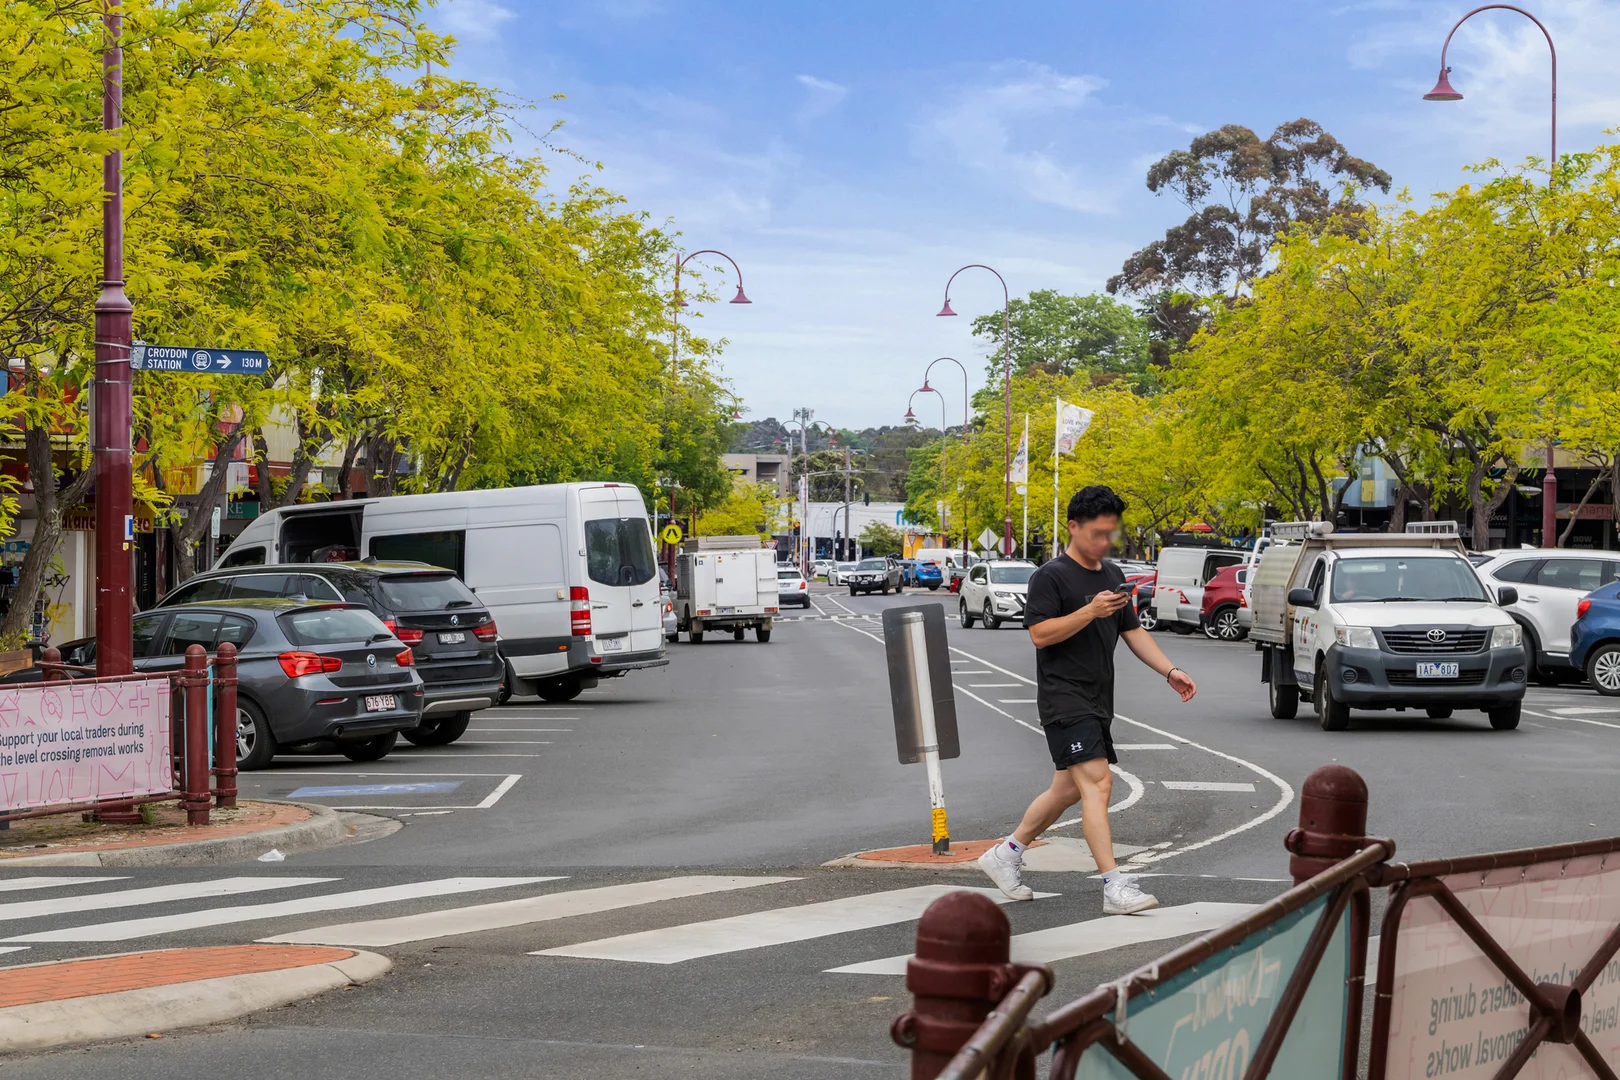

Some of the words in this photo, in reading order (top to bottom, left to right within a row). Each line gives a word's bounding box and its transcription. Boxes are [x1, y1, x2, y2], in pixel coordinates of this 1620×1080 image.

[147, 347, 188, 359] CROYDON
[147, 358, 182, 370] STATION
[1573, 535, 1593, 543] now
[0, 731, 34, 749] upport
[37, 731, 59, 747] your
[60, 727, 84, 742] local
[85, 724, 116, 739] traders
[117, 722, 144, 738] during
[0, 753, 13, 766] he
[15, 749, 38, 765] level
[41, 746, 81, 763] crossing
[82, 742, 116, 758] removal
[118, 740, 144, 755] works
